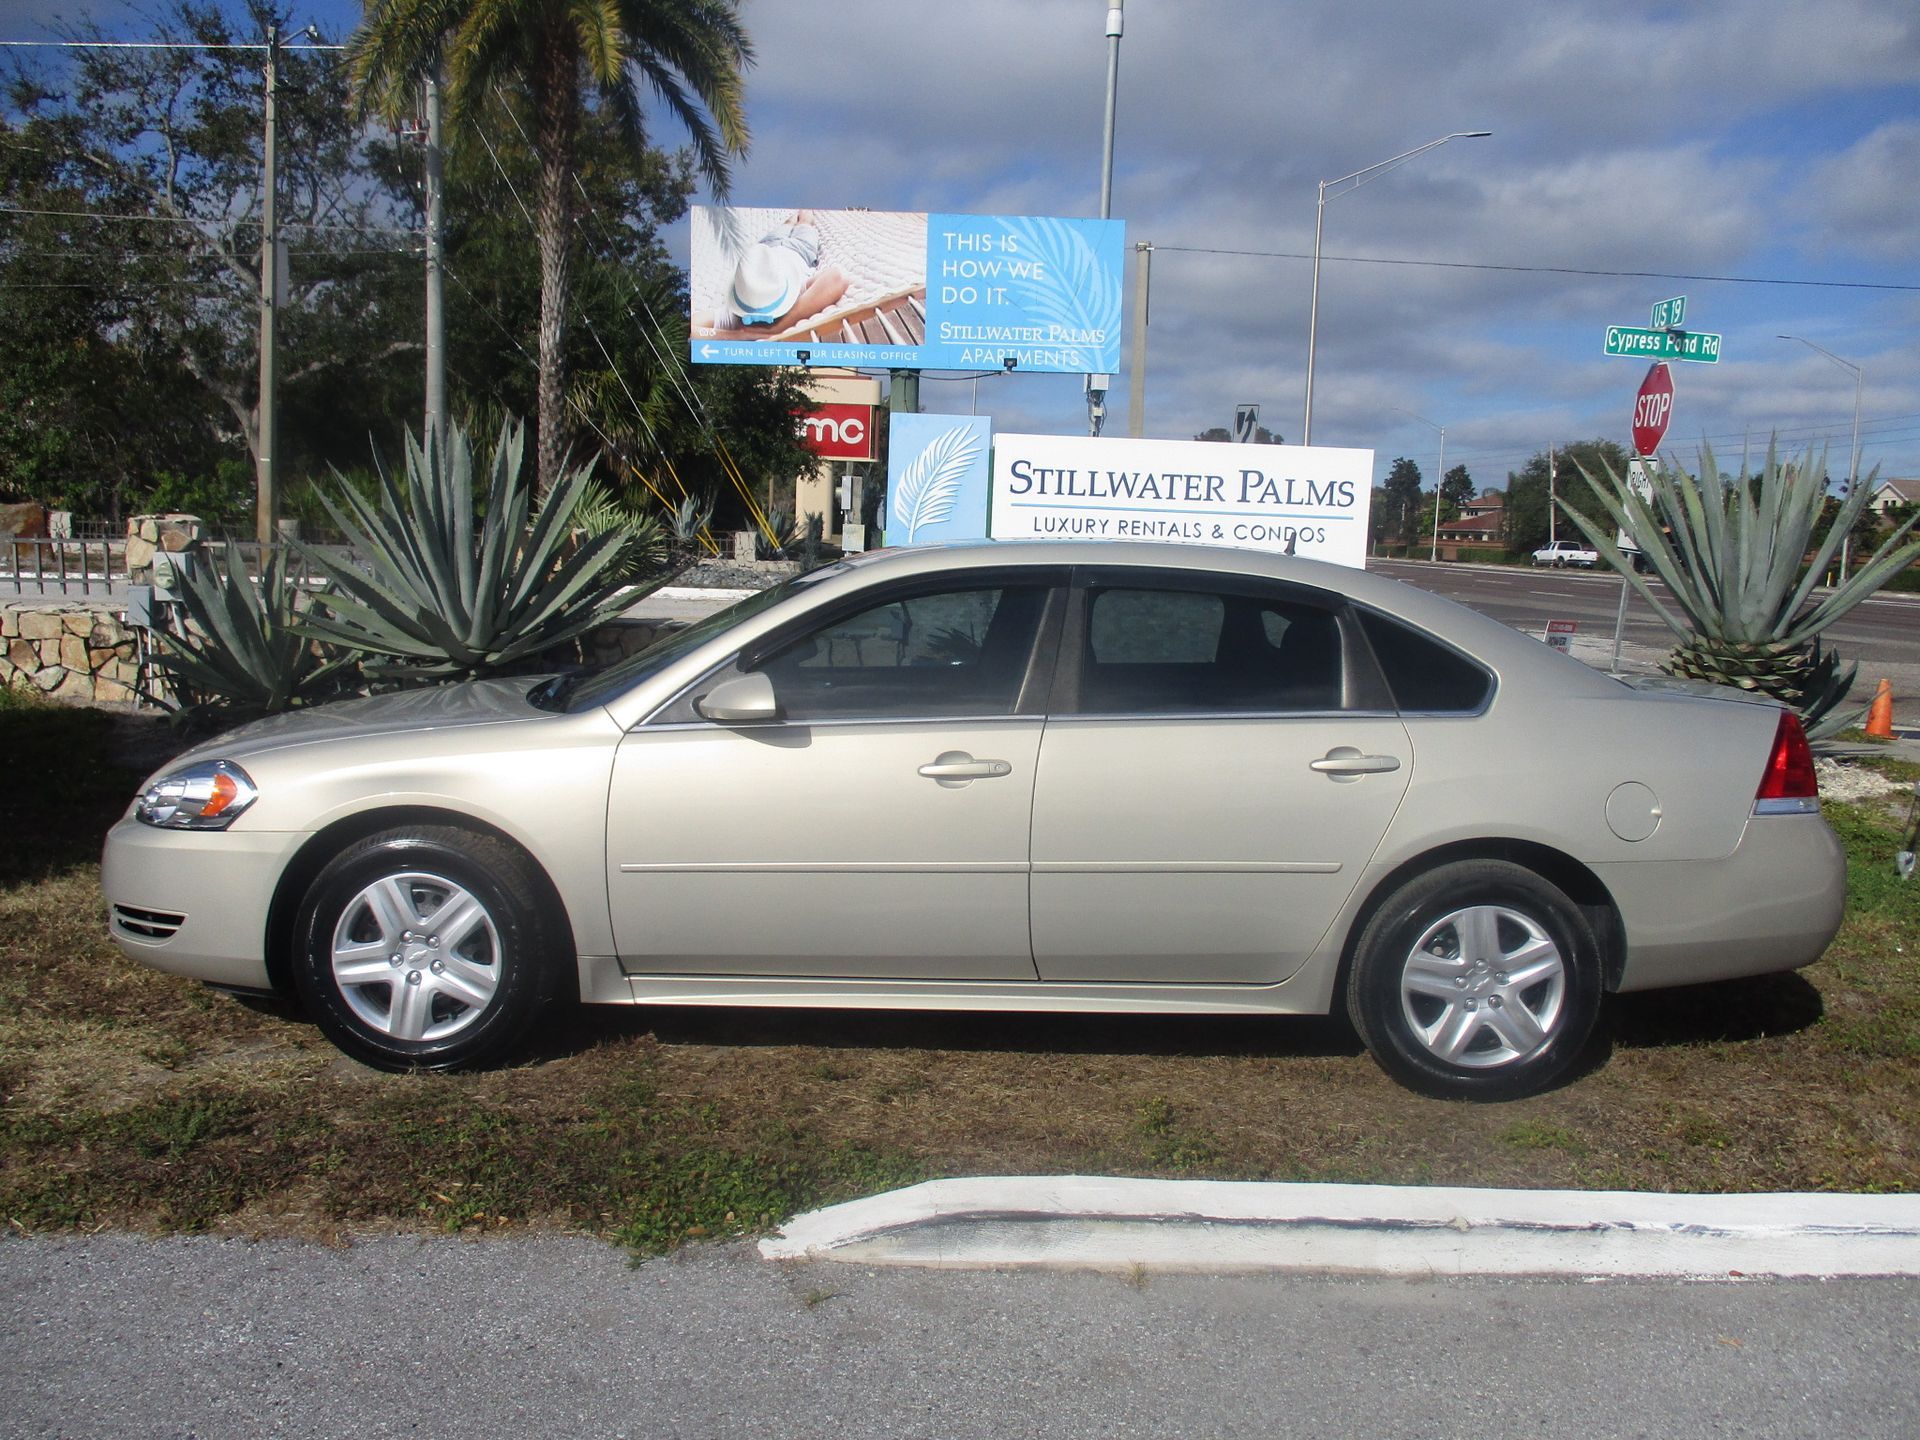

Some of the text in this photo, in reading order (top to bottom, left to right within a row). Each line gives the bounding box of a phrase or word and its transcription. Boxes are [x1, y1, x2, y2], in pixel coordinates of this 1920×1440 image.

[942, 232, 1018, 253] THIS IS
[942, 260, 1045, 280] HOW WE
[942, 286, 1009, 306] DO IT.
[1654, 299, 1682, 328] US 19
[940, 321, 1106, 344] STILLWATER PALMS
[1608, 328, 1719, 355] Cypress Pond Rd
[723, 347, 754, 359] TURN
[757, 348, 782, 359] LEFT
[809, 349, 827, 359] UR
[832, 349, 876, 360] LEASING
[880, 350, 919, 361] OFFICE
[960, 348, 1080, 367] APARTMENTS
[1635, 392, 1671, 428] STOP
[795, 417, 865, 445] mc
[1009, 460, 1355, 507] STILLWATER PALMS
[1034, 516, 1325, 543] LUXURY RENTALS & CONDOS
